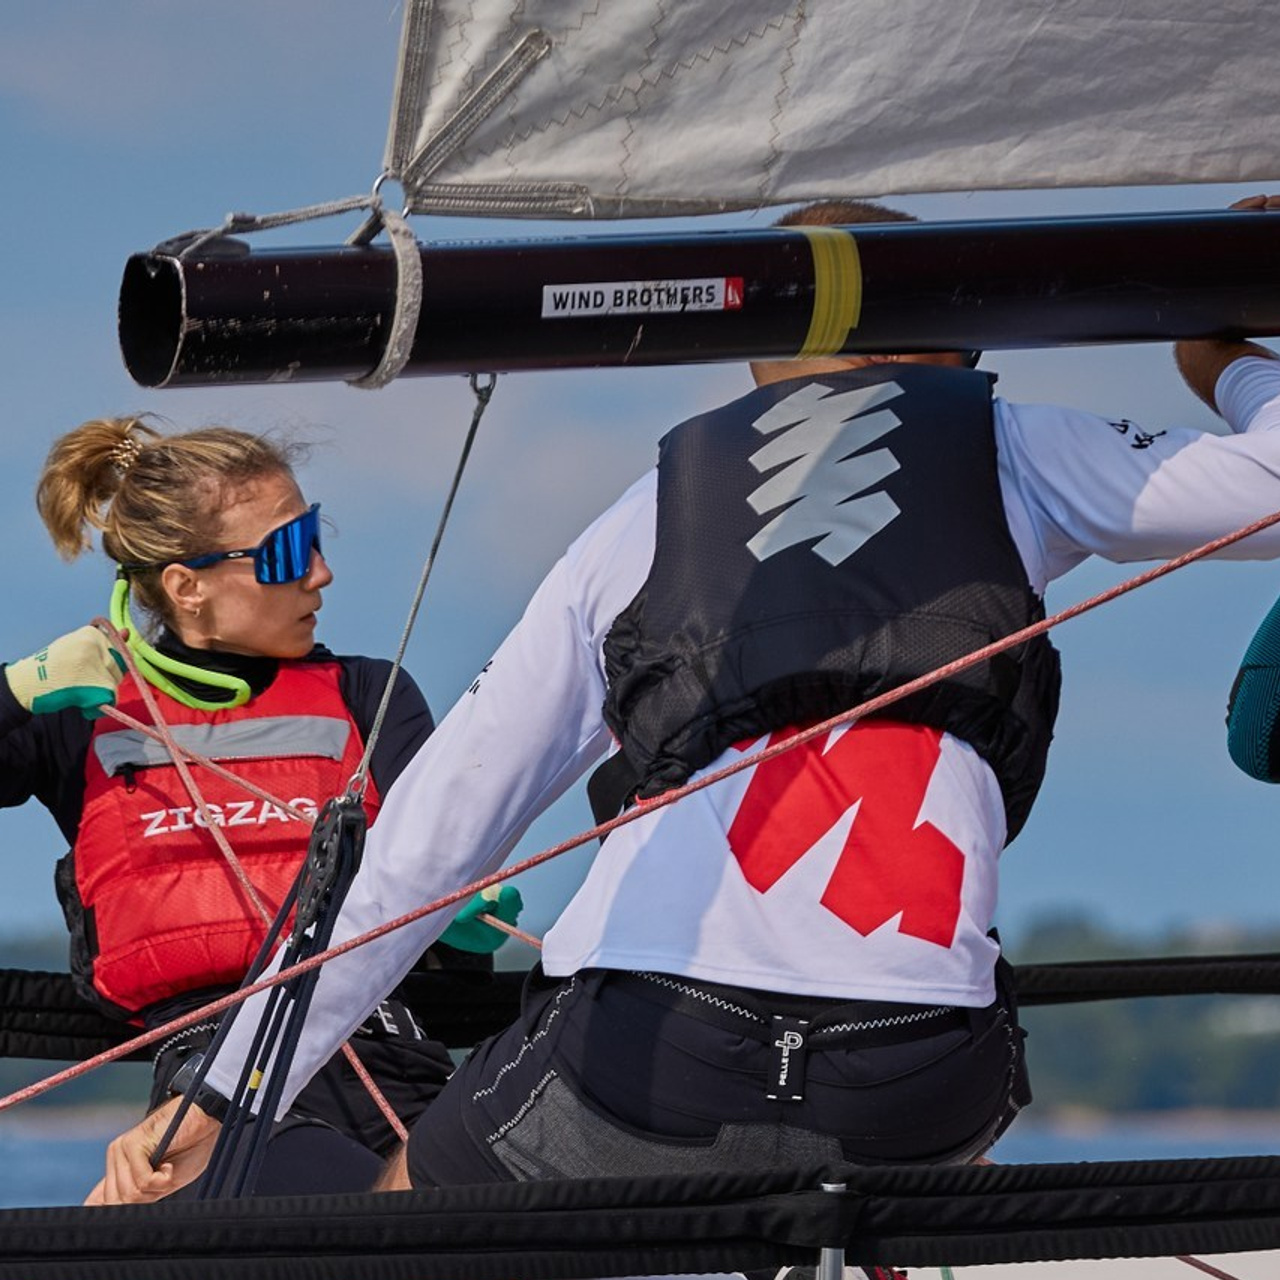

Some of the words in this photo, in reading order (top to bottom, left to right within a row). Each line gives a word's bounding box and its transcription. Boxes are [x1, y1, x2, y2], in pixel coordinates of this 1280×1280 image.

[552, 290, 605, 311] WIND
[612, 284, 716, 308] BROTHERS
[140, 796, 319, 837] ZIGZAG
